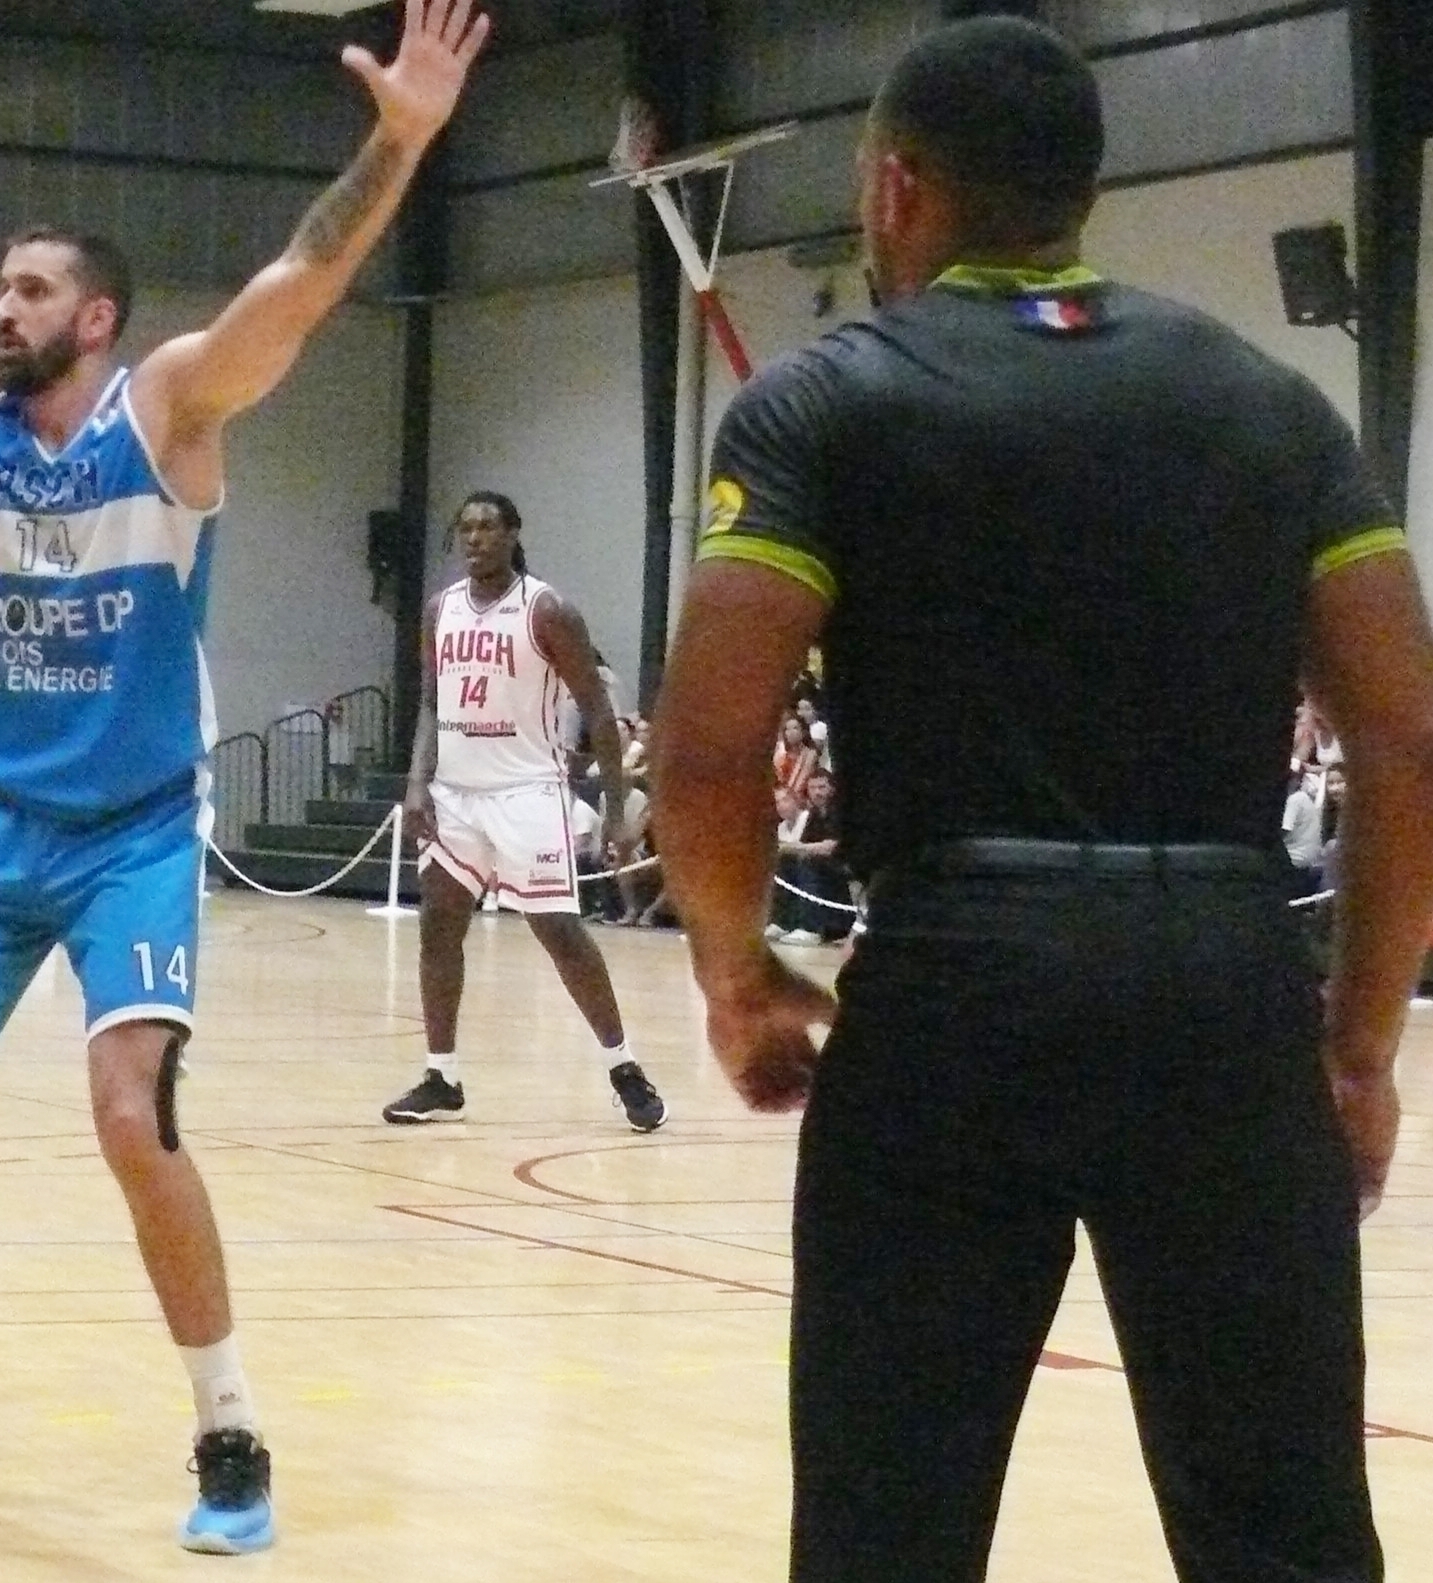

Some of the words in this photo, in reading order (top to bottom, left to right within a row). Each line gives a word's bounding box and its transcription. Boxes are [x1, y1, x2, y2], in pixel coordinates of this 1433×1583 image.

[16, 518, 78, 574] 14
[96, 589, 134, 632] DP
[439, 629, 516, 679] AUCH
[459, 675, 489, 709] 14
[132, 941, 189, 996] 14
